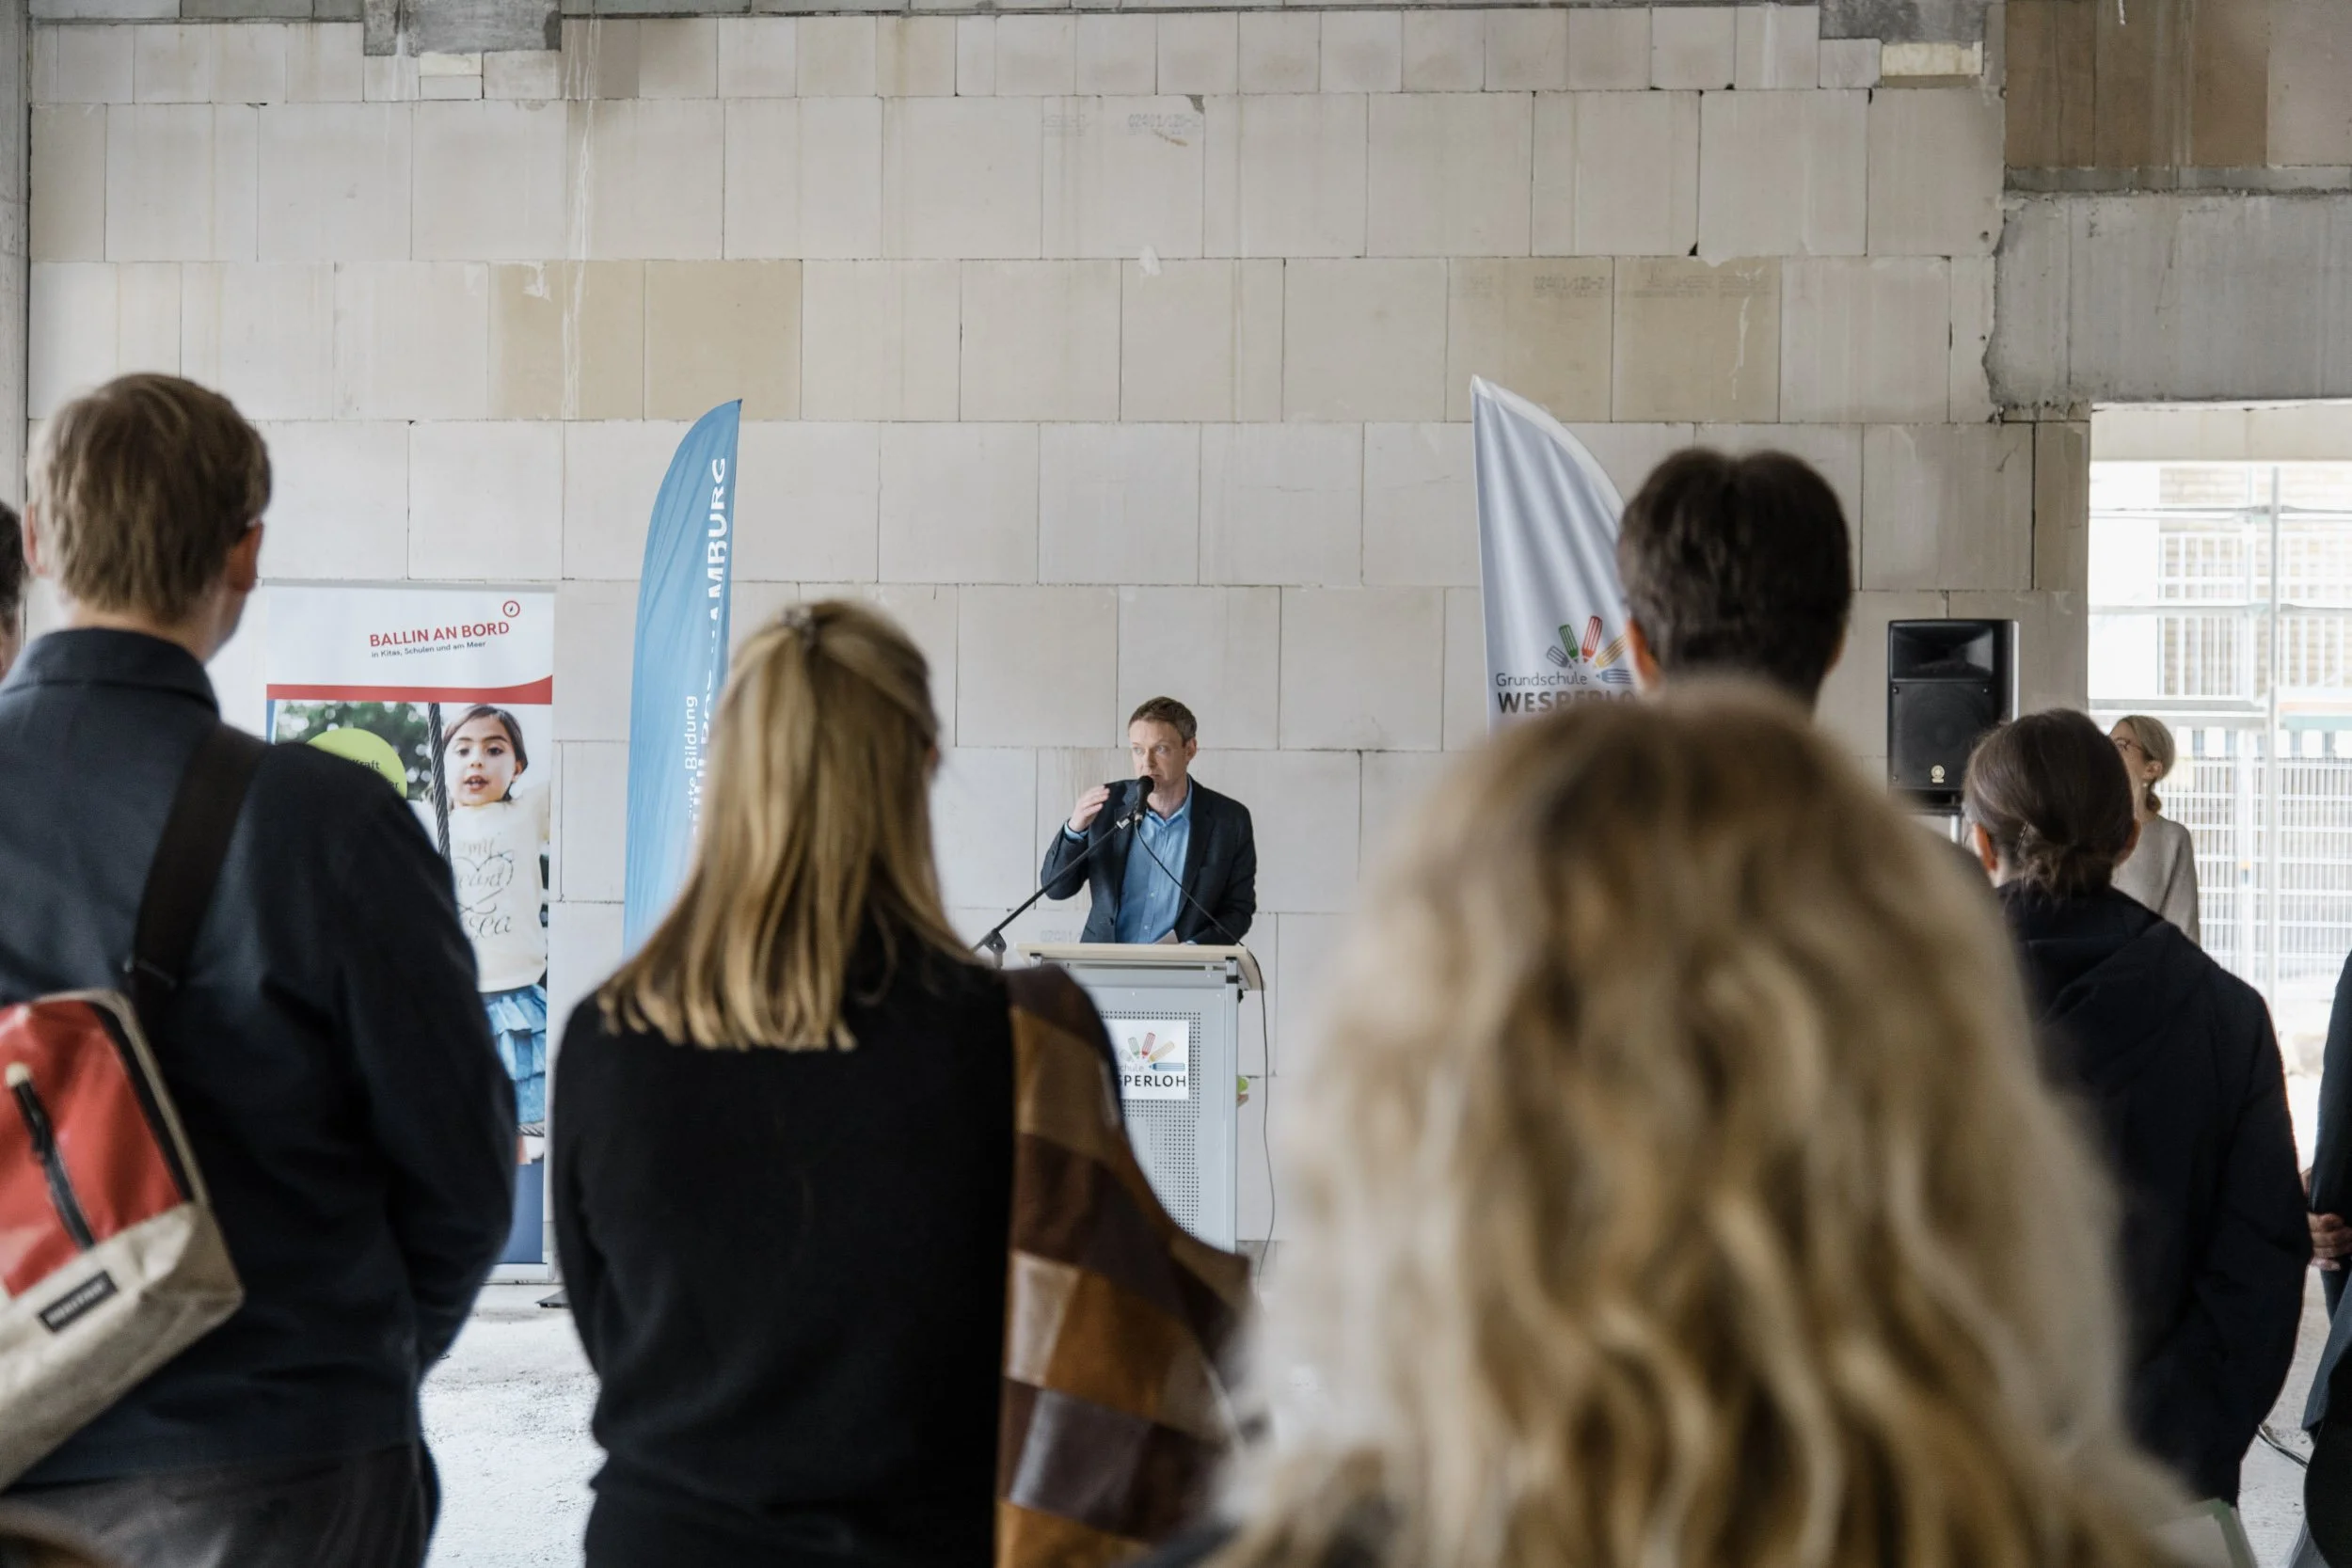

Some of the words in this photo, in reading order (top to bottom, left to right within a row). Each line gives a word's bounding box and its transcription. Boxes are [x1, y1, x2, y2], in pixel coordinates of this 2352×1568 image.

[370, 628, 429, 647] BALLIN
[433, 626, 457, 641] AN
[461, 622, 510, 639] BORD
[381, 647, 403, 657] Kitas,
[405, 645, 435, 656] Schulen
[437, 643, 451, 652] und
[467, 641, 486, 649] Meer
[1496, 671, 1588, 687] Grundschule
[685, 695, 698, 770] Bildung
[1121, 1074, 1186, 1087] PERLOH
